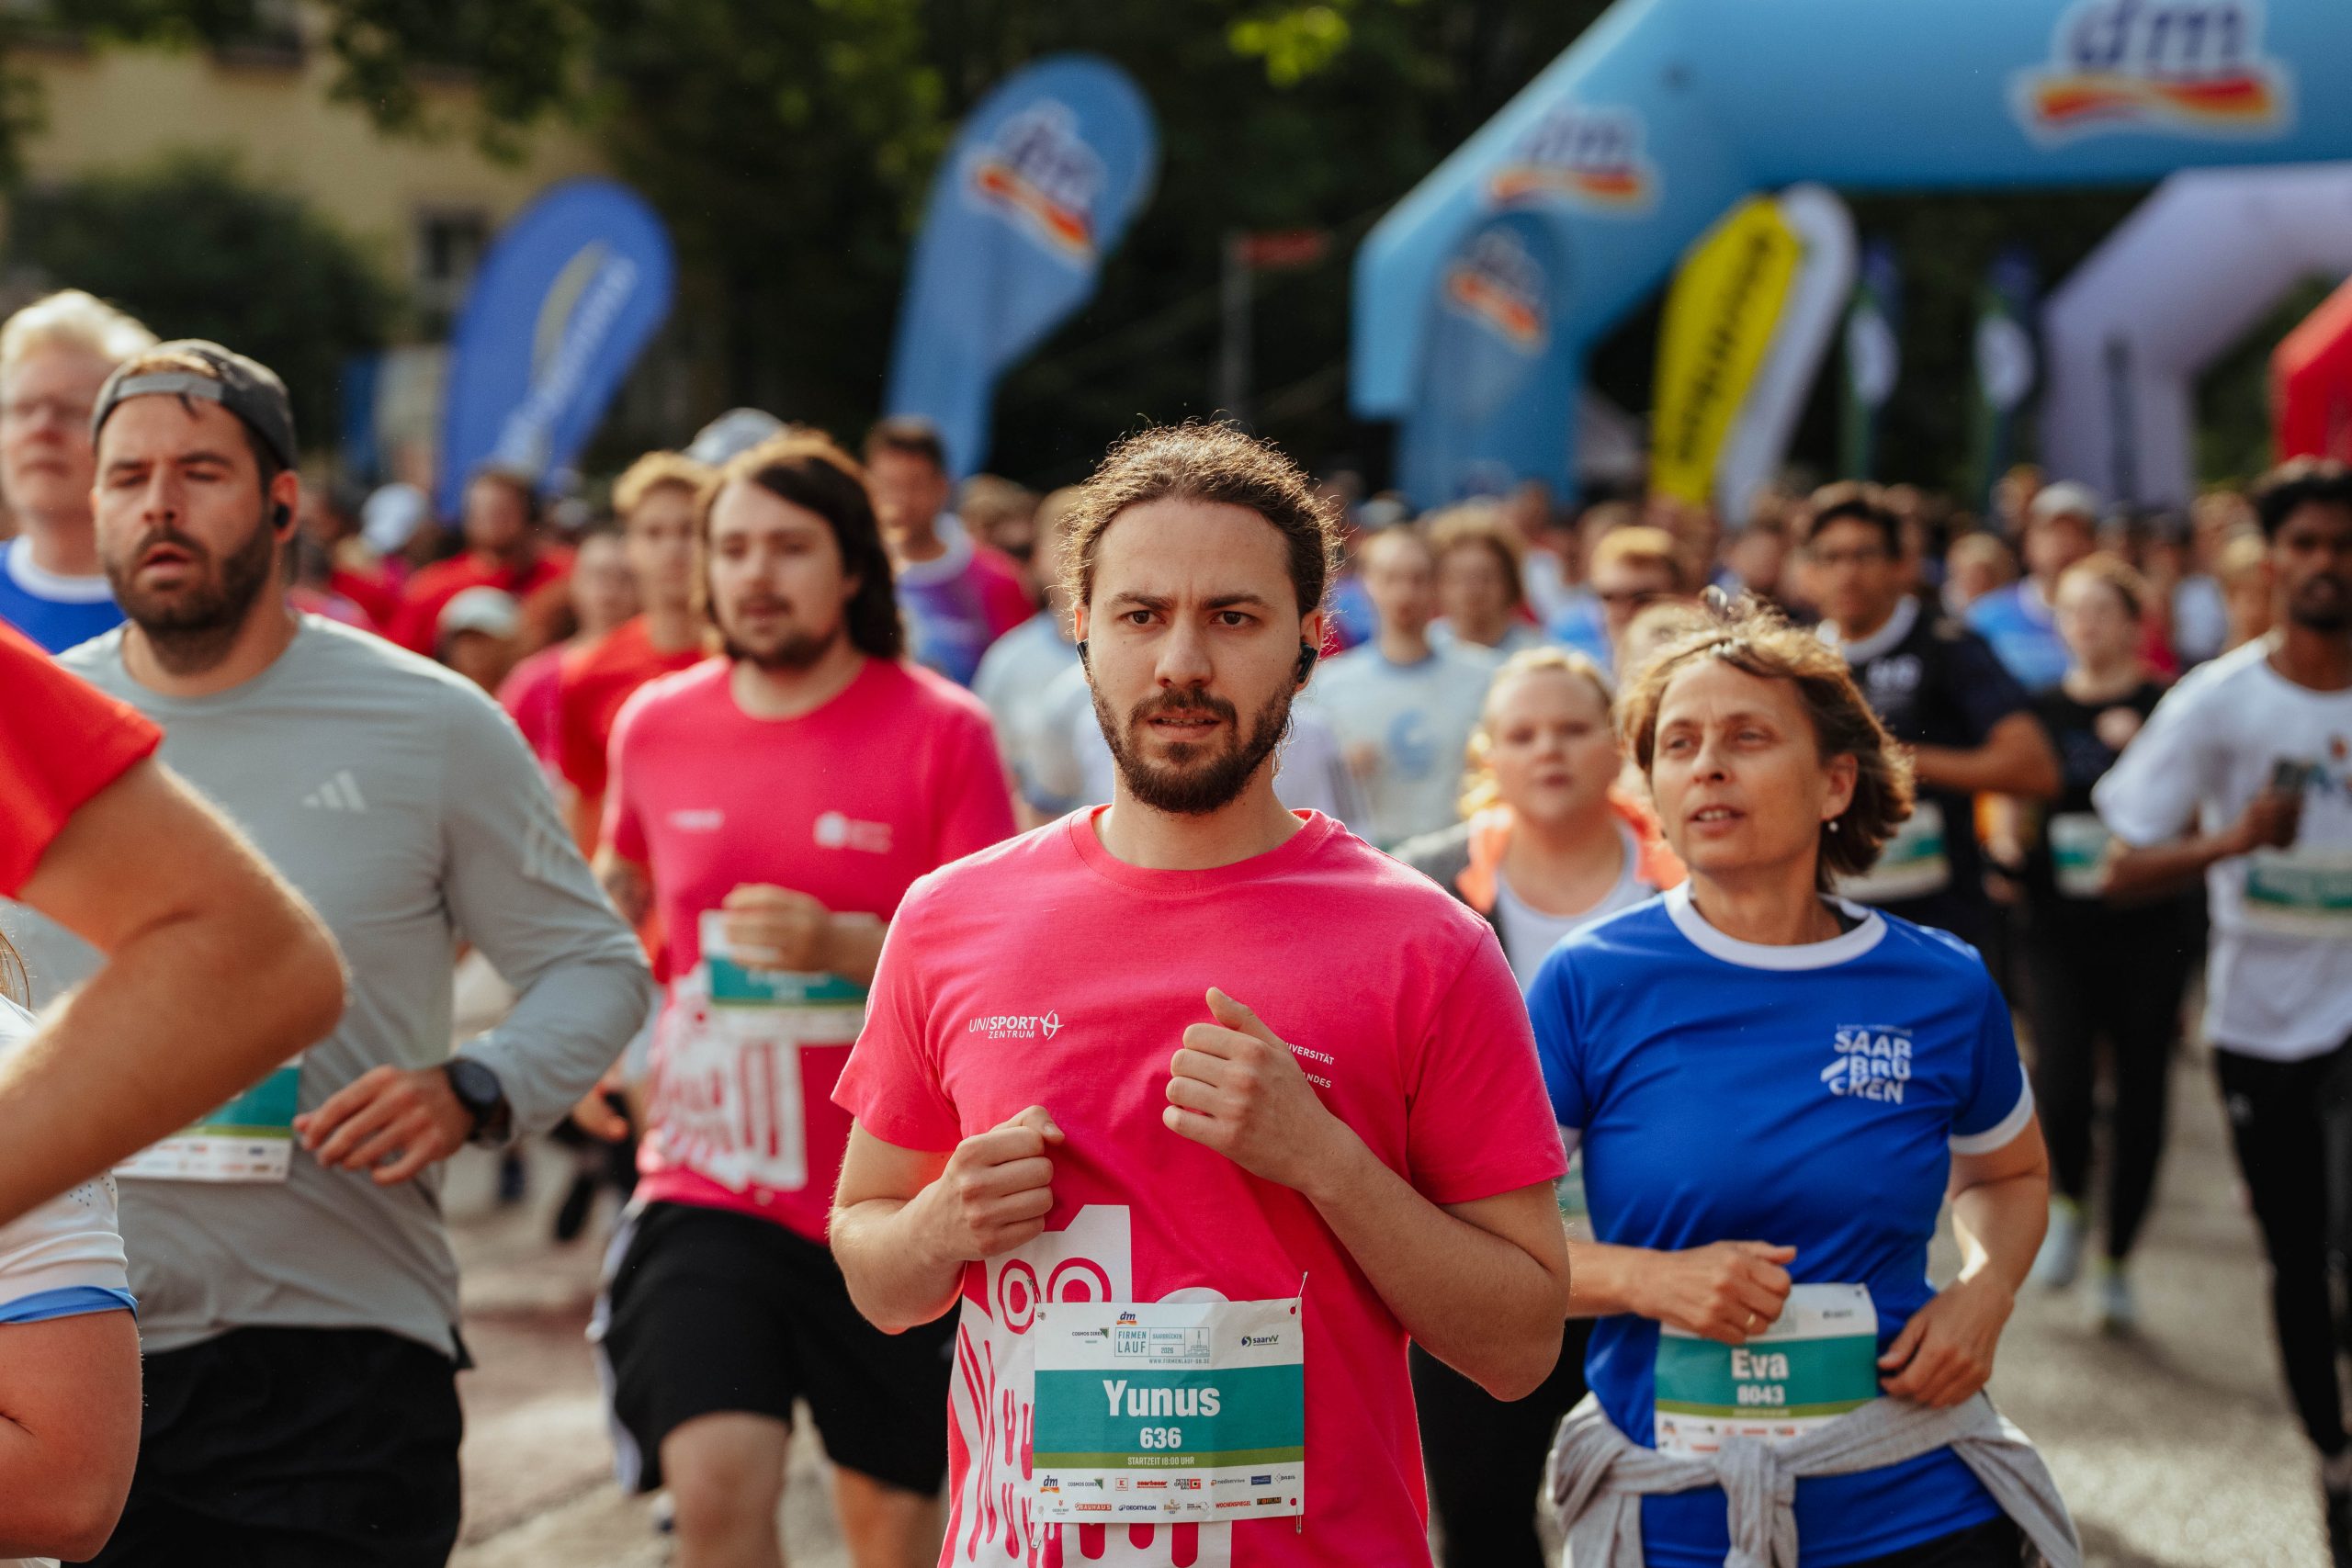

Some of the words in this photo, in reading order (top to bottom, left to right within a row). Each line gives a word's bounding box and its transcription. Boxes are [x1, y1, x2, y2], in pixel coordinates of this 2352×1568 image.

[2069, 0, 2245, 75] dm
[968, 1015, 1039, 1032] UNISPORT
[988, 1030, 1035, 1039] ZENTRUM
[1834, 1029, 1913, 1060] SAAR
[1286, 1042, 1335, 1066] IVERSITÄT
[1303, 1071, 1332, 1089] NDES
[1119, 1311, 1136, 1321] dm
[1117, 1330, 1147, 1339] FIRMEN
[1117, 1341, 1147, 1353] LAUF
[1731, 1348, 1790, 1380] Eva
[1102, 1380, 1221, 1417] Yunus
[1139, 1427, 1182, 1449] 636
[1127, 1456, 1160, 1466] STARTZEIT
[1161, 1456, 1180, 1466] 18:00
[1181, 1455, 1195, 1465] UHR
[1043, 1474, 1058, 1487] dm
